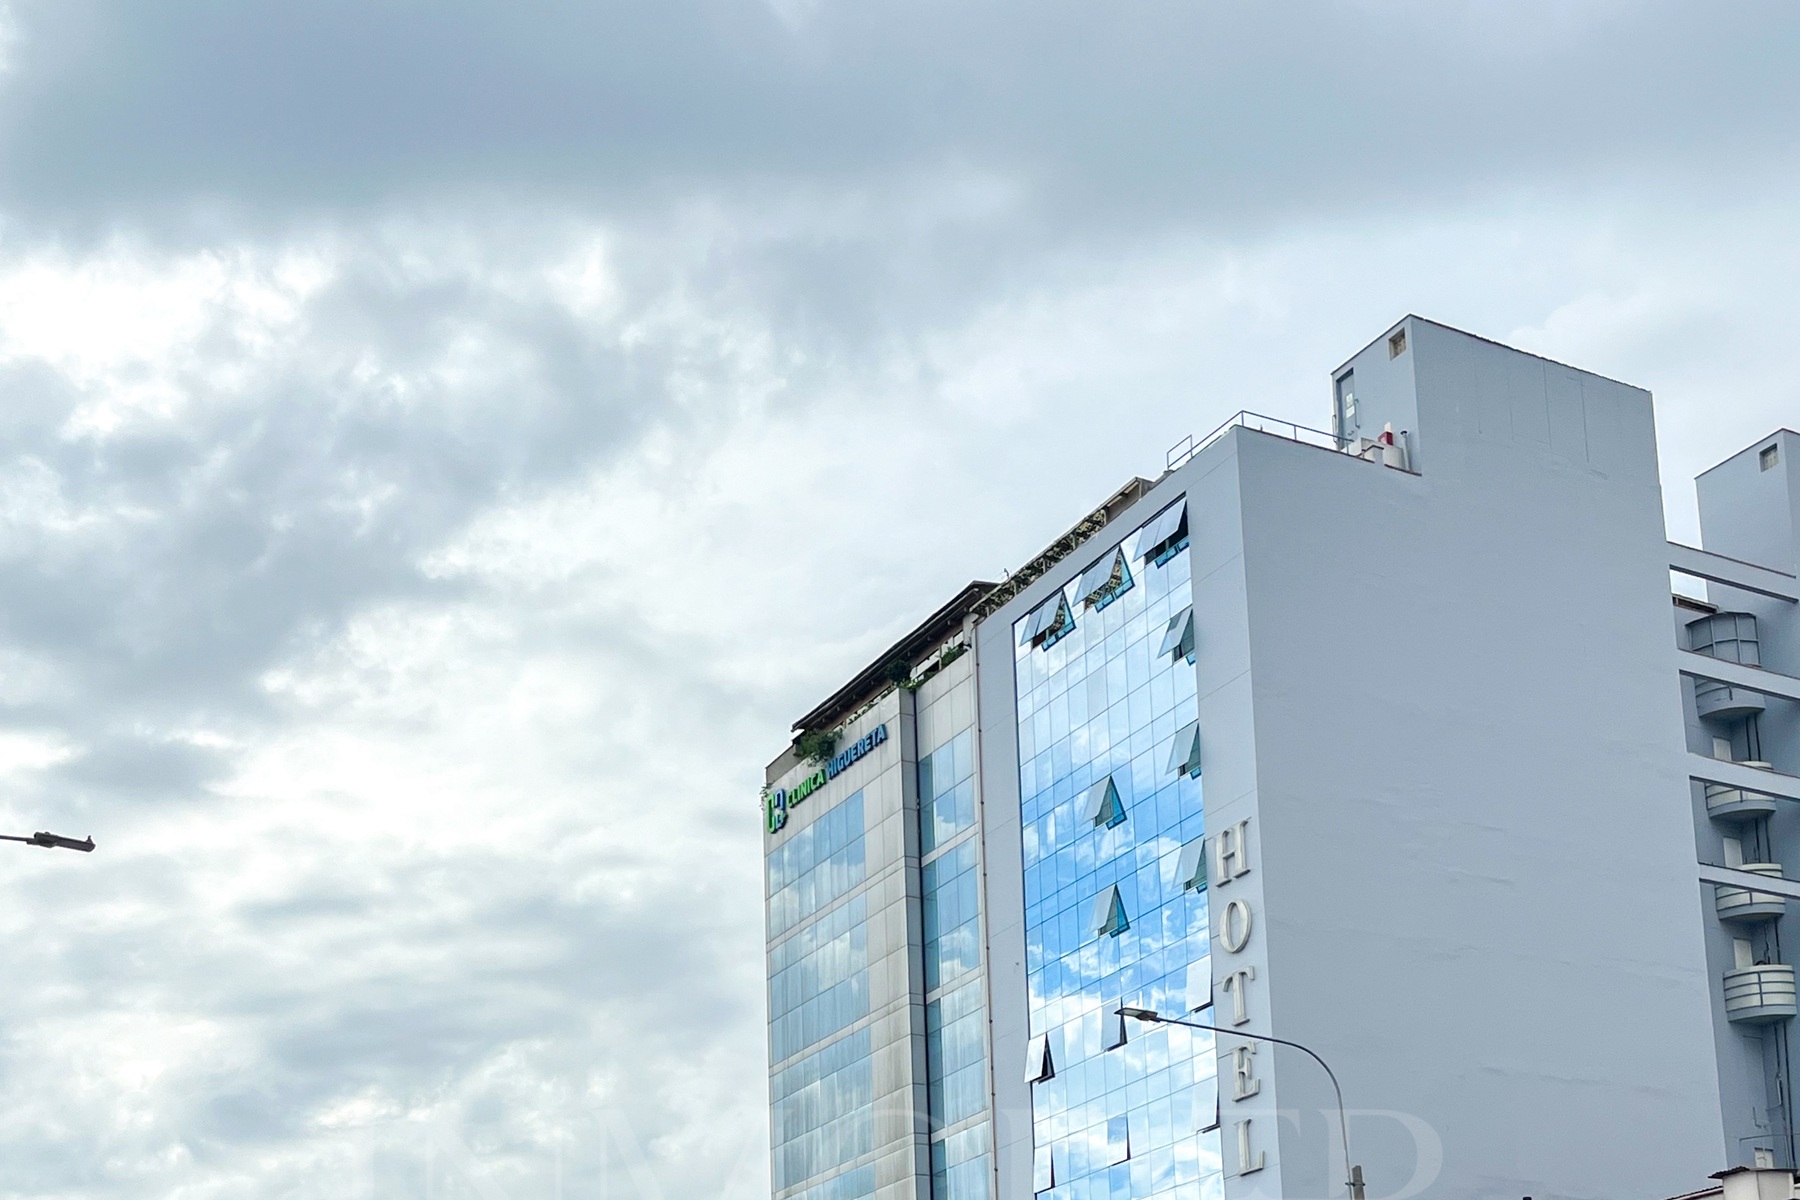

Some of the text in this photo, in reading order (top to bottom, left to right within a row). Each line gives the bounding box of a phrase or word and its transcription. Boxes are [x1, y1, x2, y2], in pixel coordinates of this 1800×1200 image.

[787, 723, 888, 809] CLINICA HIGUERETA
[1215, 817, 1265, 1176] HOTEL
